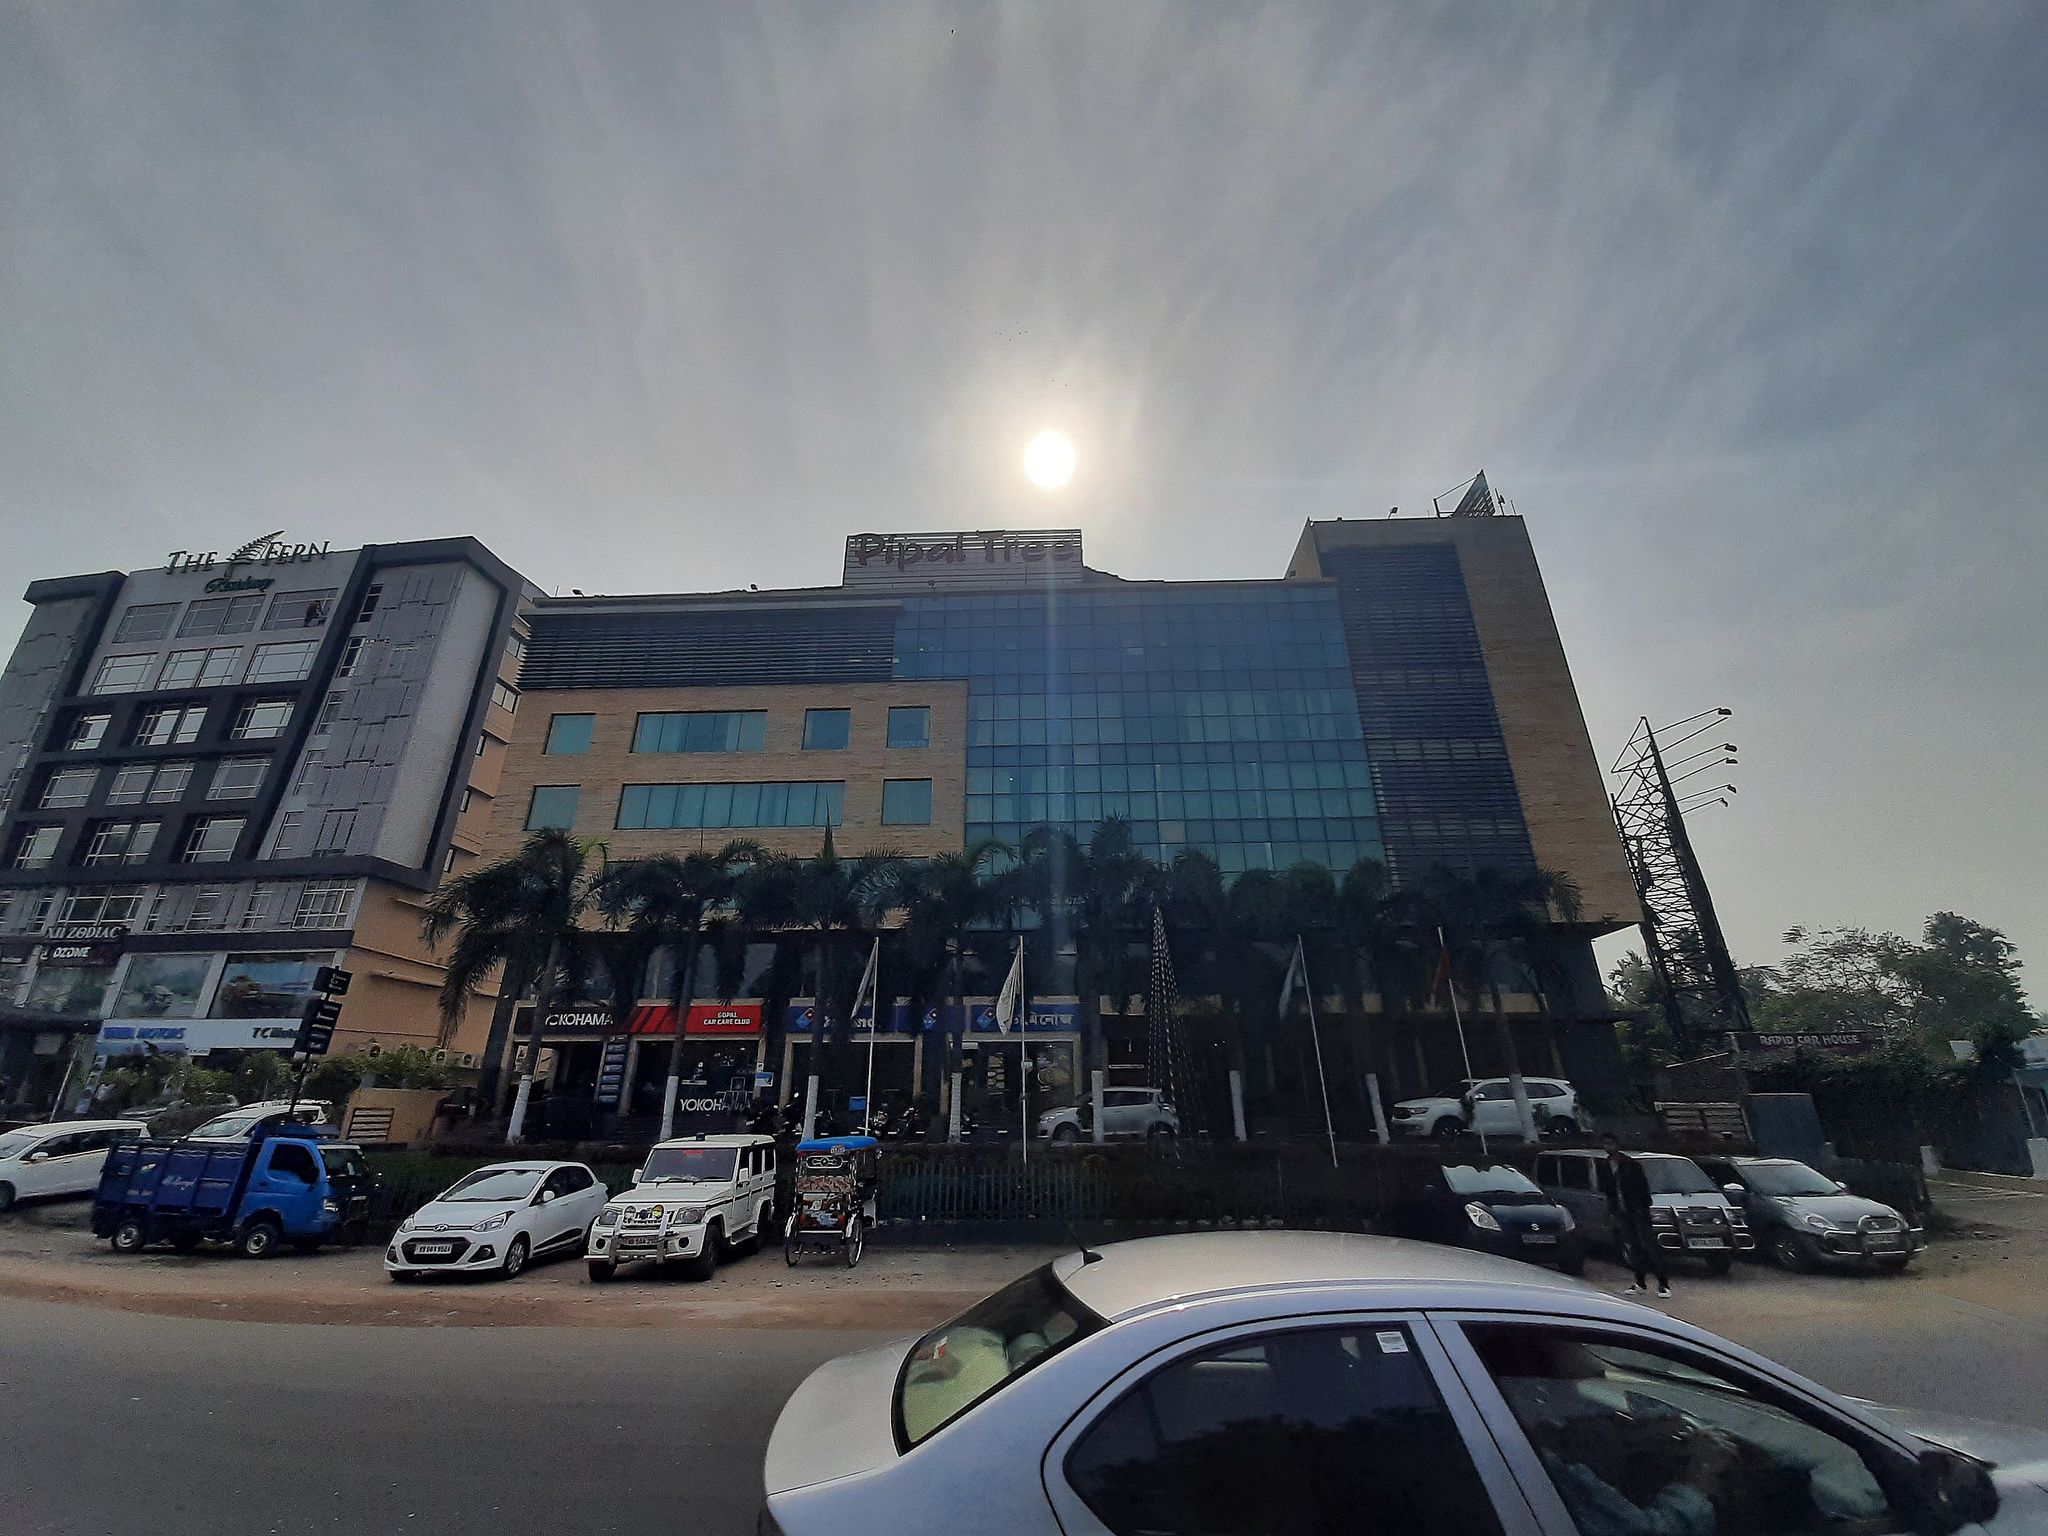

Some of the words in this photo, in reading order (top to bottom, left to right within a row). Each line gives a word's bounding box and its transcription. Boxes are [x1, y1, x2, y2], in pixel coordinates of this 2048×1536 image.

[855, 533, 967, 572] Pipal
[978, 529, 1075, 564] Tree
[164, 550, 218, 574] THE
[262, 541, 330, 566] FERN
[66, 926, 122, 939] ZODIAC
[53, 946, 92, 959] OZONE
[1759, 1035, 1794, 1046] RAPID
[1797, 1035, 1820, 1046] CAR
[1821, 1034, 1860, 1045] HOUSE
